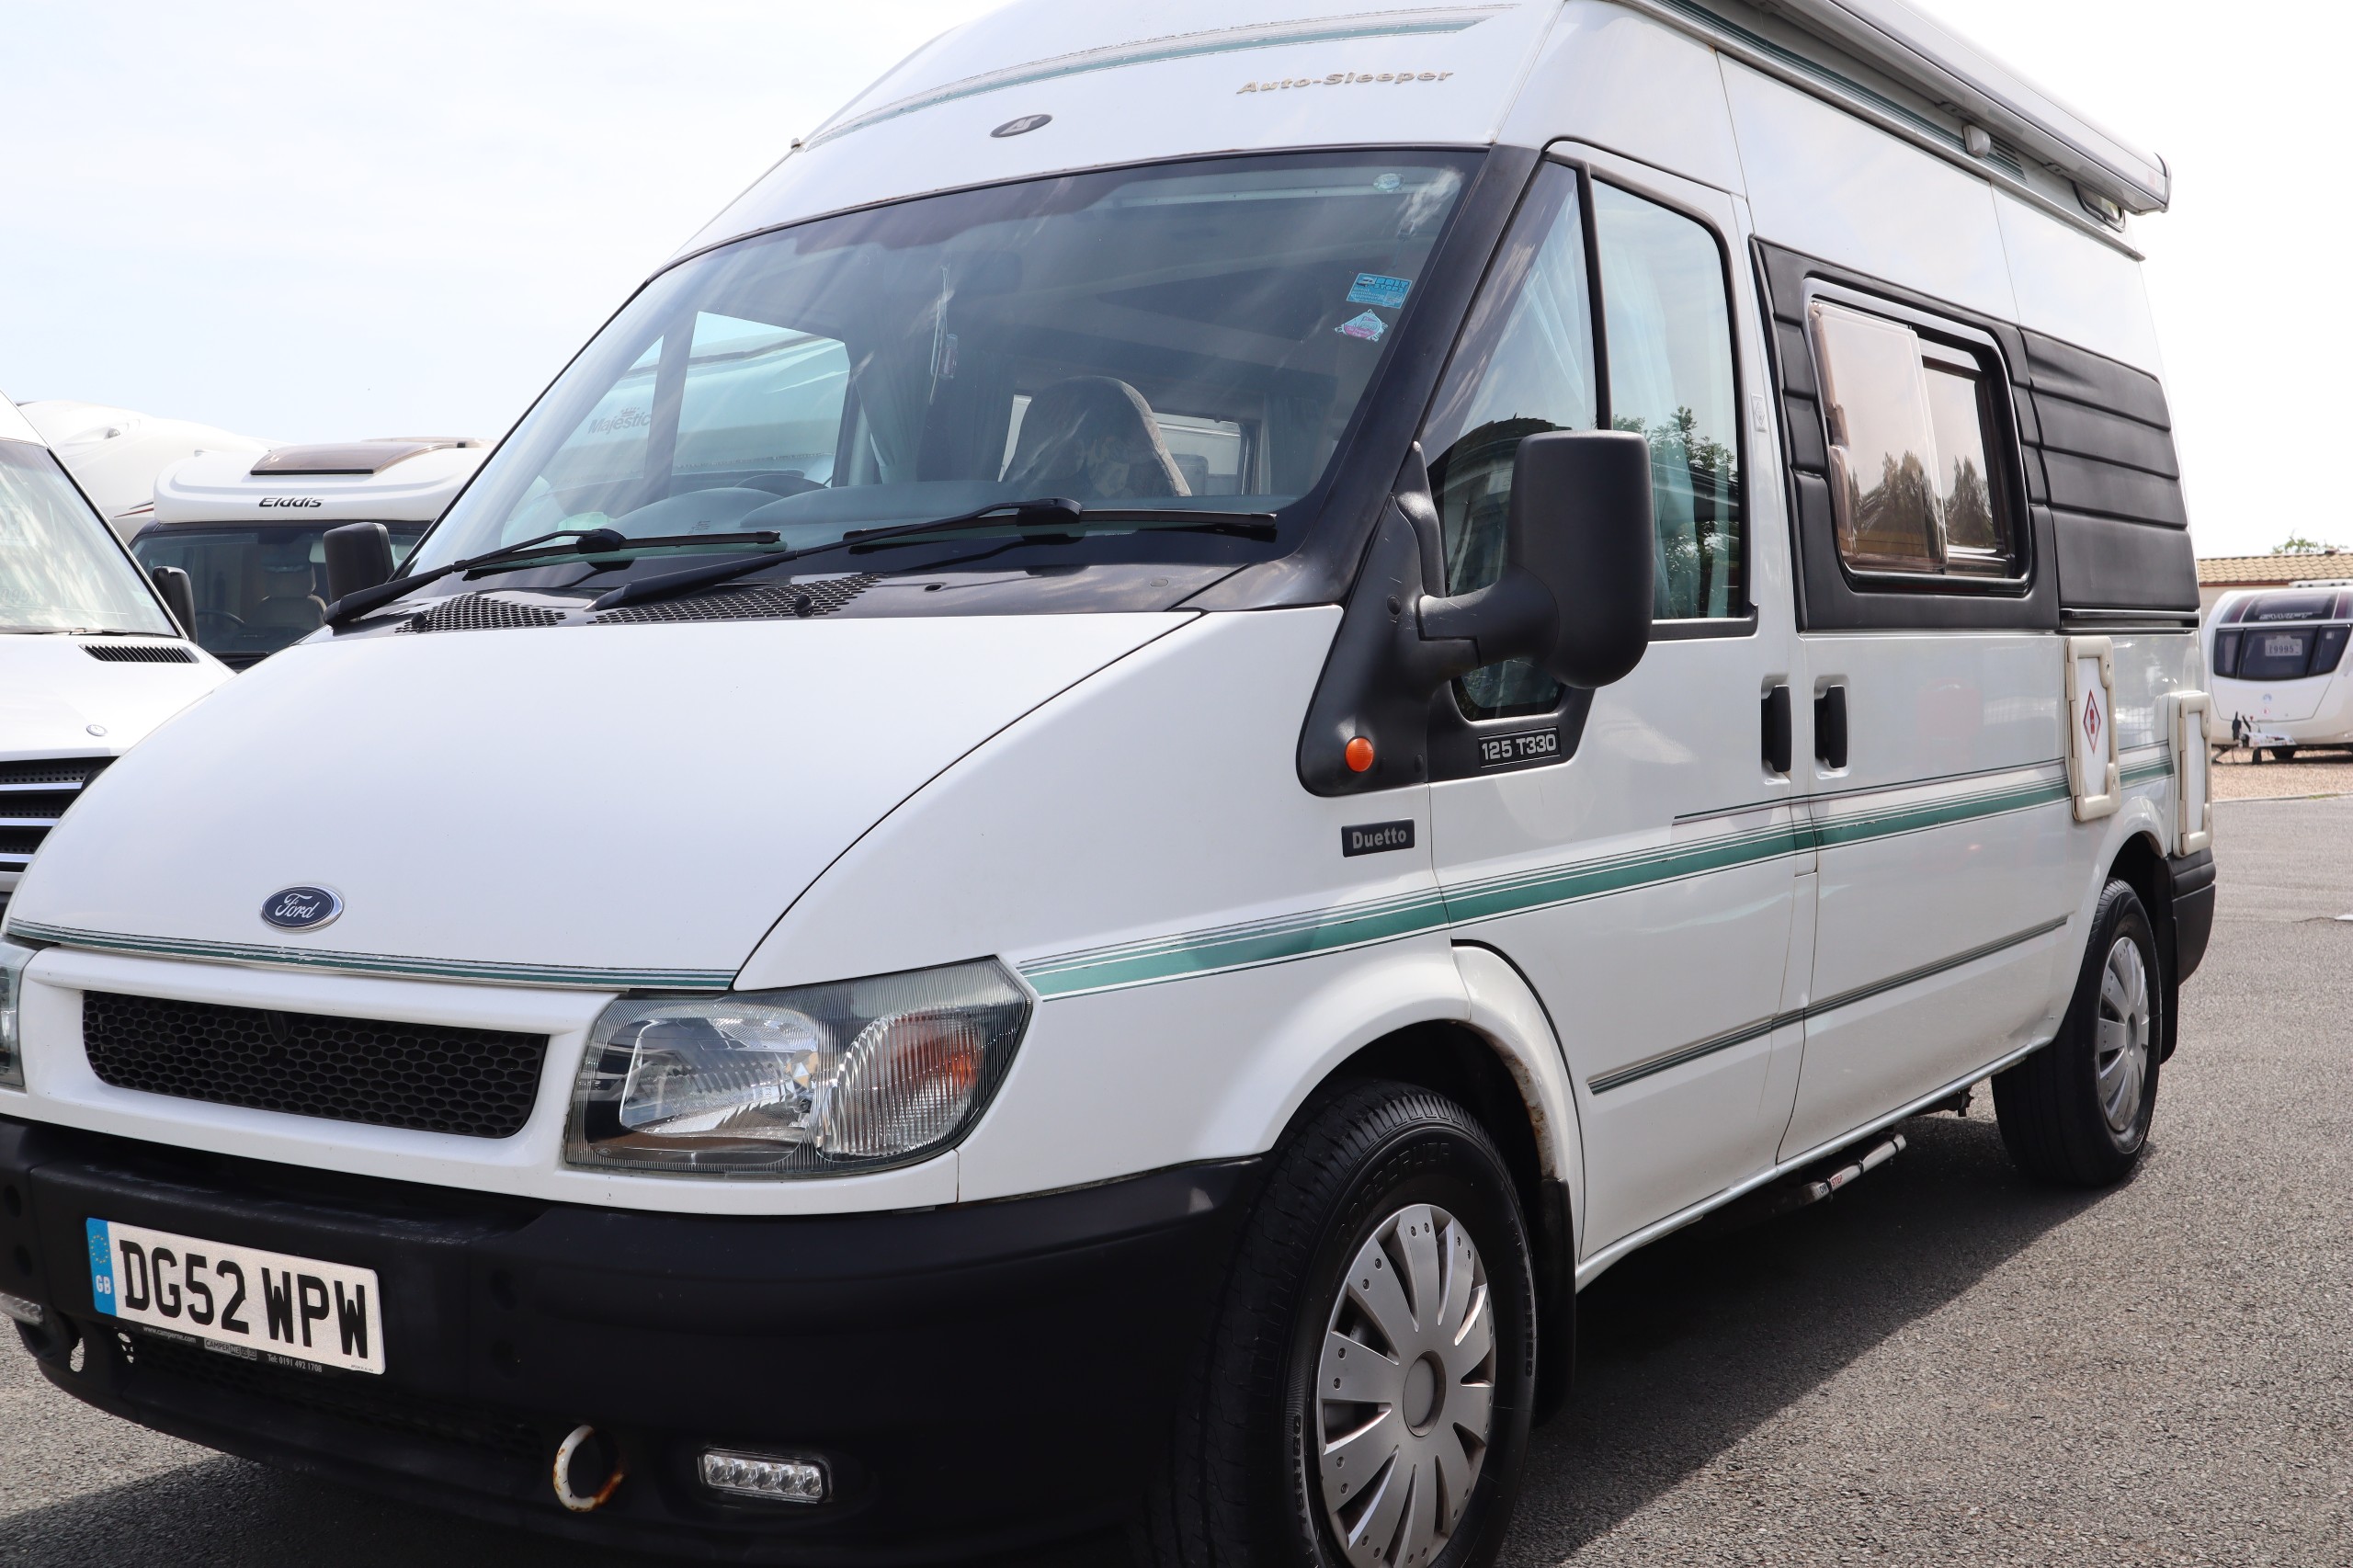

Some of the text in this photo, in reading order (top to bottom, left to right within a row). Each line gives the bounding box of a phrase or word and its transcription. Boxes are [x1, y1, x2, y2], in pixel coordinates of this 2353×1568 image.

[1235, 71, 1454, 94] Auto-Sleeper
[588, 411, 652, 435] Majestic
[258, 497, 324, 507] Elddis
[1481, 733, 1557, 761] 125 T330
[1352, 827, 1408, 849] Duetto
[275, 892, 320, 918] Ford
[96, 1275, 111, 1294] GB
[119, 1239, 369, 1359] DG52 WPW
[278, 1356, 293, 1367] 0191
[294, 1359, 306, 1369] 492
